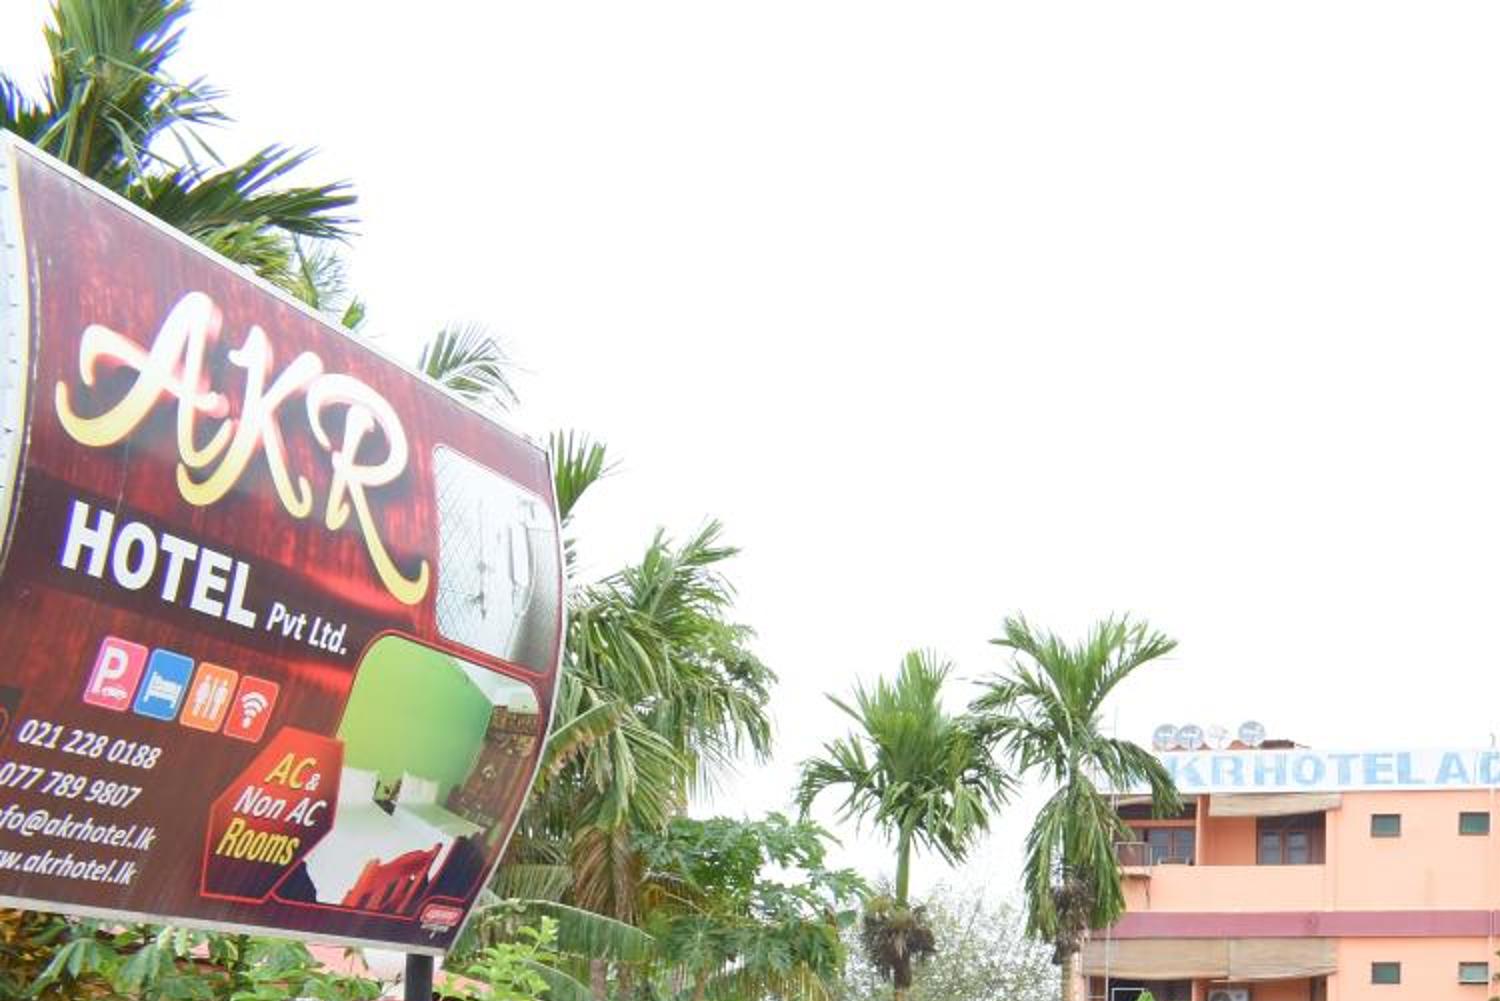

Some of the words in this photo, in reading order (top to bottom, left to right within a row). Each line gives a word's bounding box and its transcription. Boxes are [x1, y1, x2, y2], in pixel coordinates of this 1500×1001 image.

[55, 291, 429, 605] AKR
[61, 501, 257, 629] HOTEL
[266, 603, 304, 640] Pvt
[307, 619, 347, 655] Ltd.
[18, 720, 63, 749] 021
[63, 729, 108, 759] 228
[108, 739, 163, 769] 0188
[0, 763, 44, 790] 077
[42, 771, 86, 799] 789
[85, 781, 143, 809] 9807
[264, 753, 317, 789] AC
[305, 773, 321, 791] &
[1160, 753, 1245, 786] KR
[1254, 752, 1422, 786] HOTEL
[233, 785, 286, 819] Non
[284, 798, 327, 827] AC
[216, 817, 300, 866] Rooms
